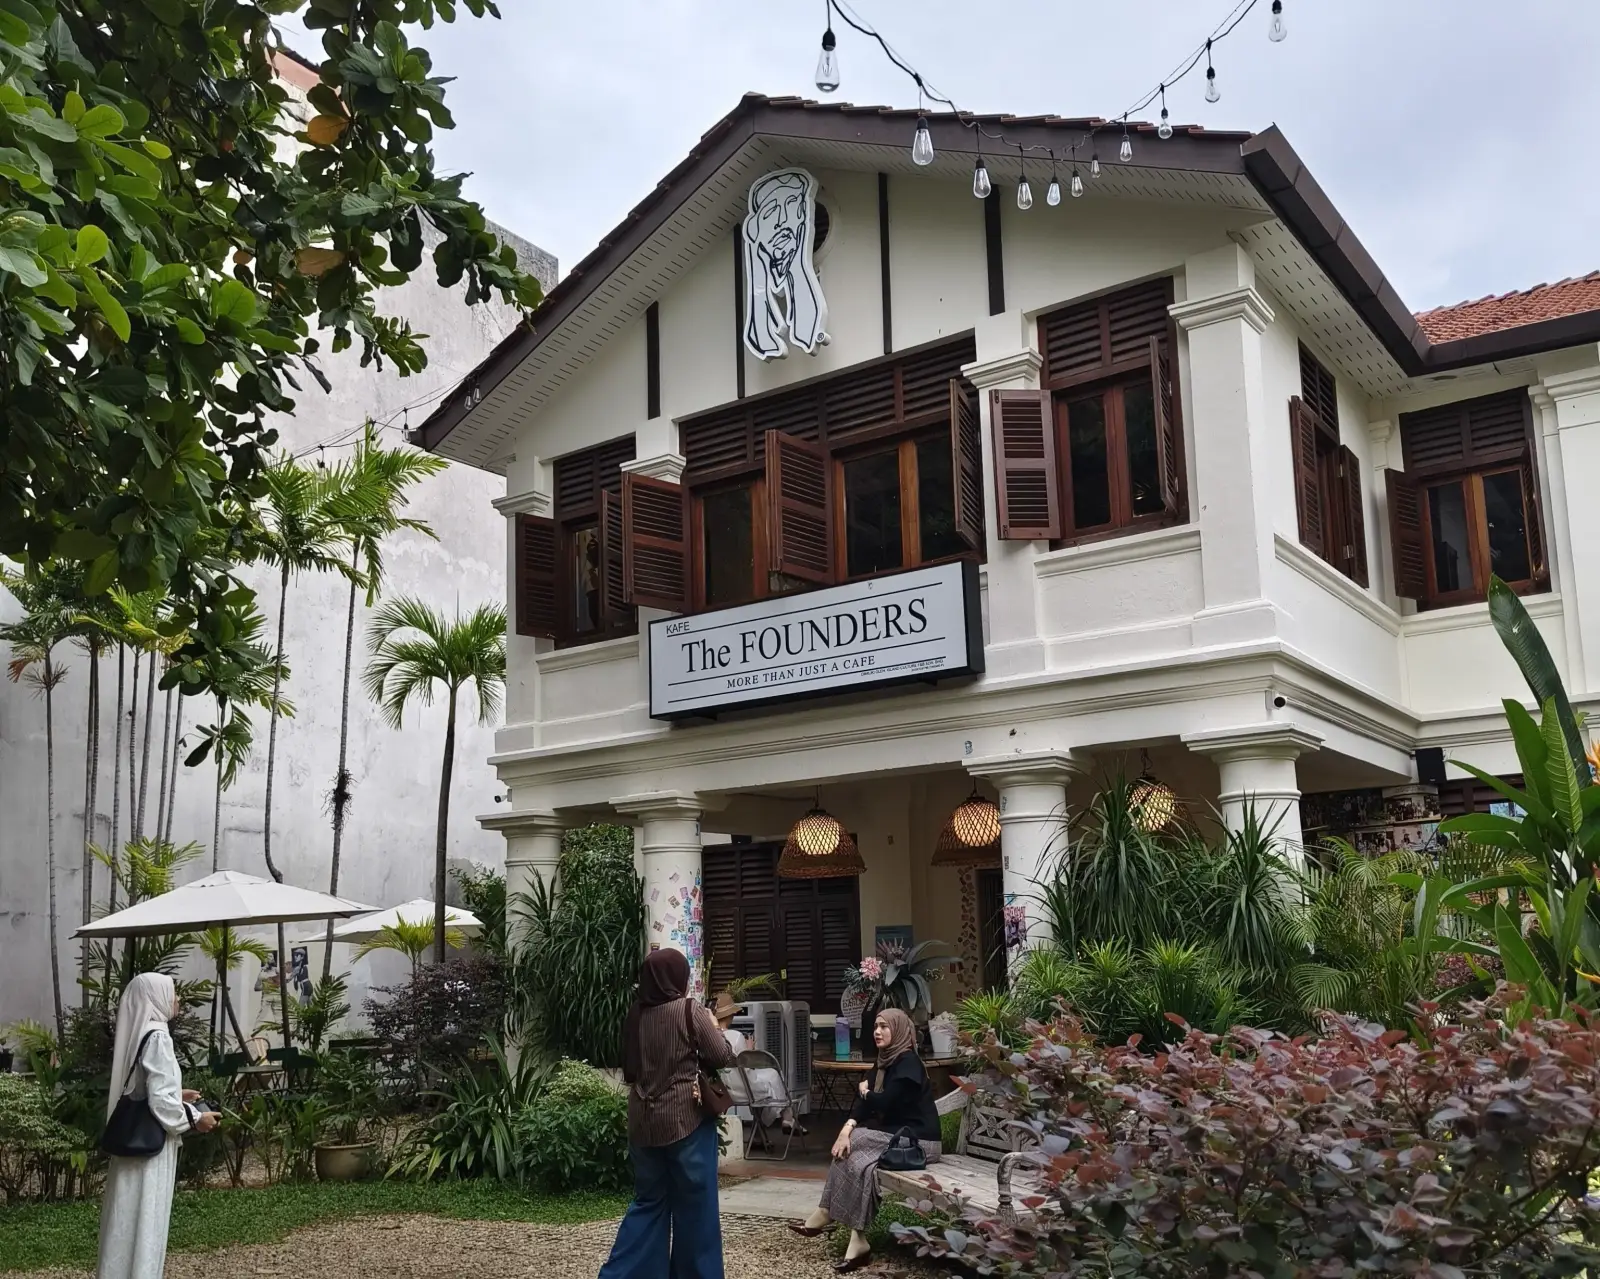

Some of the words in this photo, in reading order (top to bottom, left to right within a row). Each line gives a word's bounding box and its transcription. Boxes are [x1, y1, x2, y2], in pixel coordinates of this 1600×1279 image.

[665, 620, 690, 635] KAFE
[681, 638, 731, 674] The
[739, 597, 928, 663] FOUNDERS
[726, 674, 760, 689] MORE
[762, 668, 796, 683] THAN
[798, 663, 828, 677] JUST
[831, 661, 839, 672] A
[842, 655, 876, 669] CAFE
